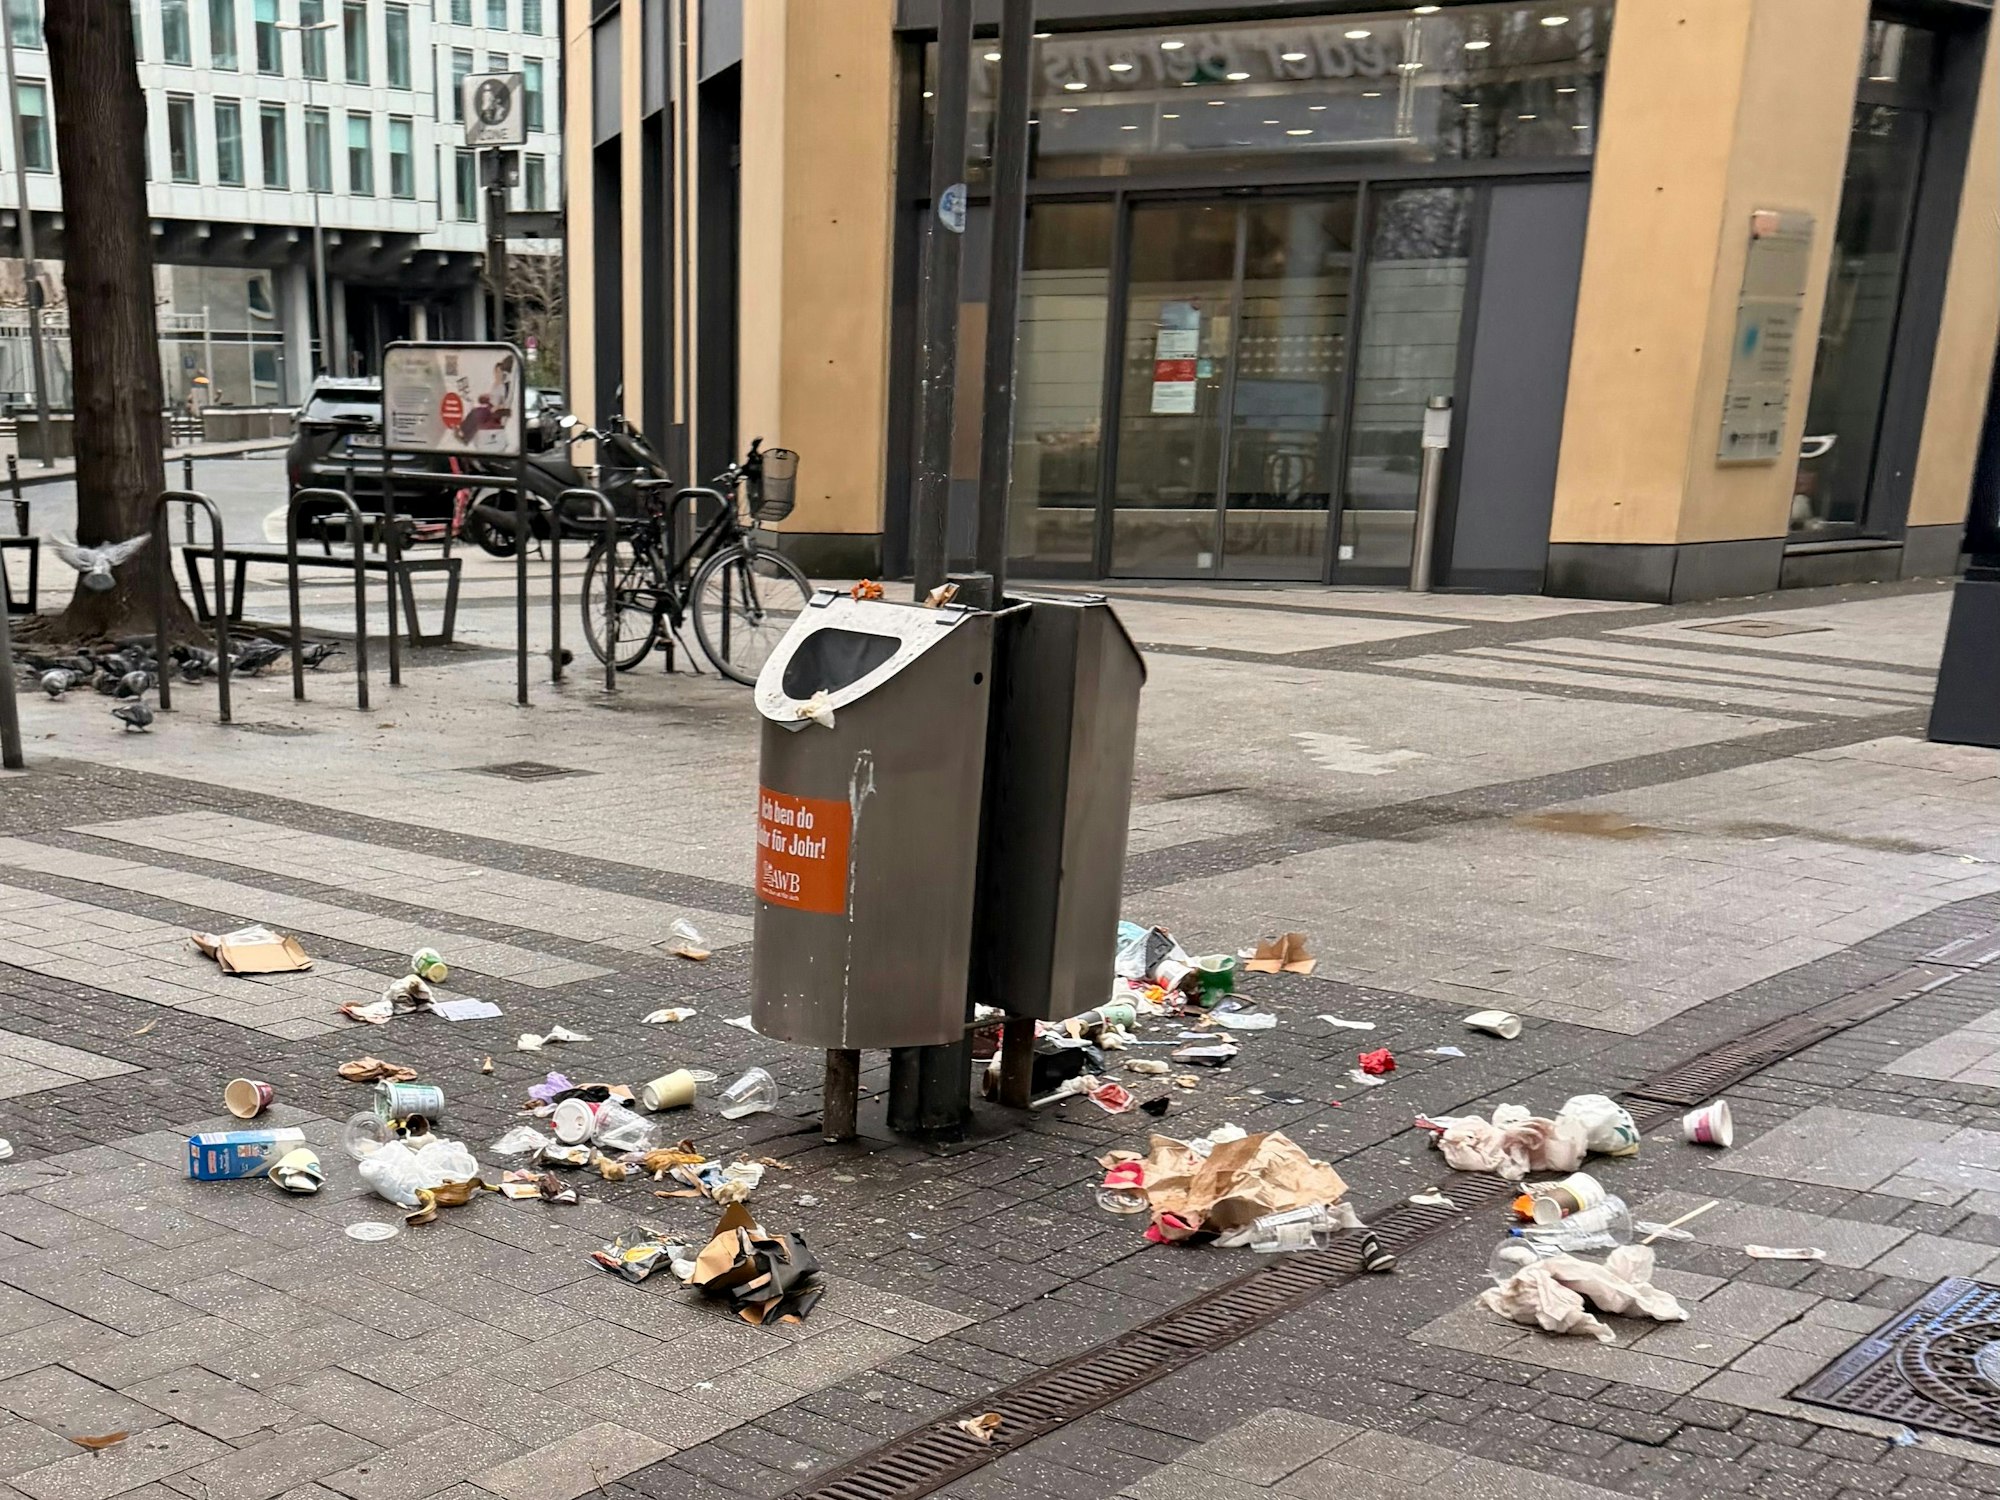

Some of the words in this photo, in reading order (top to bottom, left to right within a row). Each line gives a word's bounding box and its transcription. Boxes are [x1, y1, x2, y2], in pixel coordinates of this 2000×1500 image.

[774, 800, 794, 826] ben
[797, 806, 813, 829] do
[771, 829, 788, 853] för
[788, 833, 827, 860] Johr!
[771, 870, 800, 893] AWB
